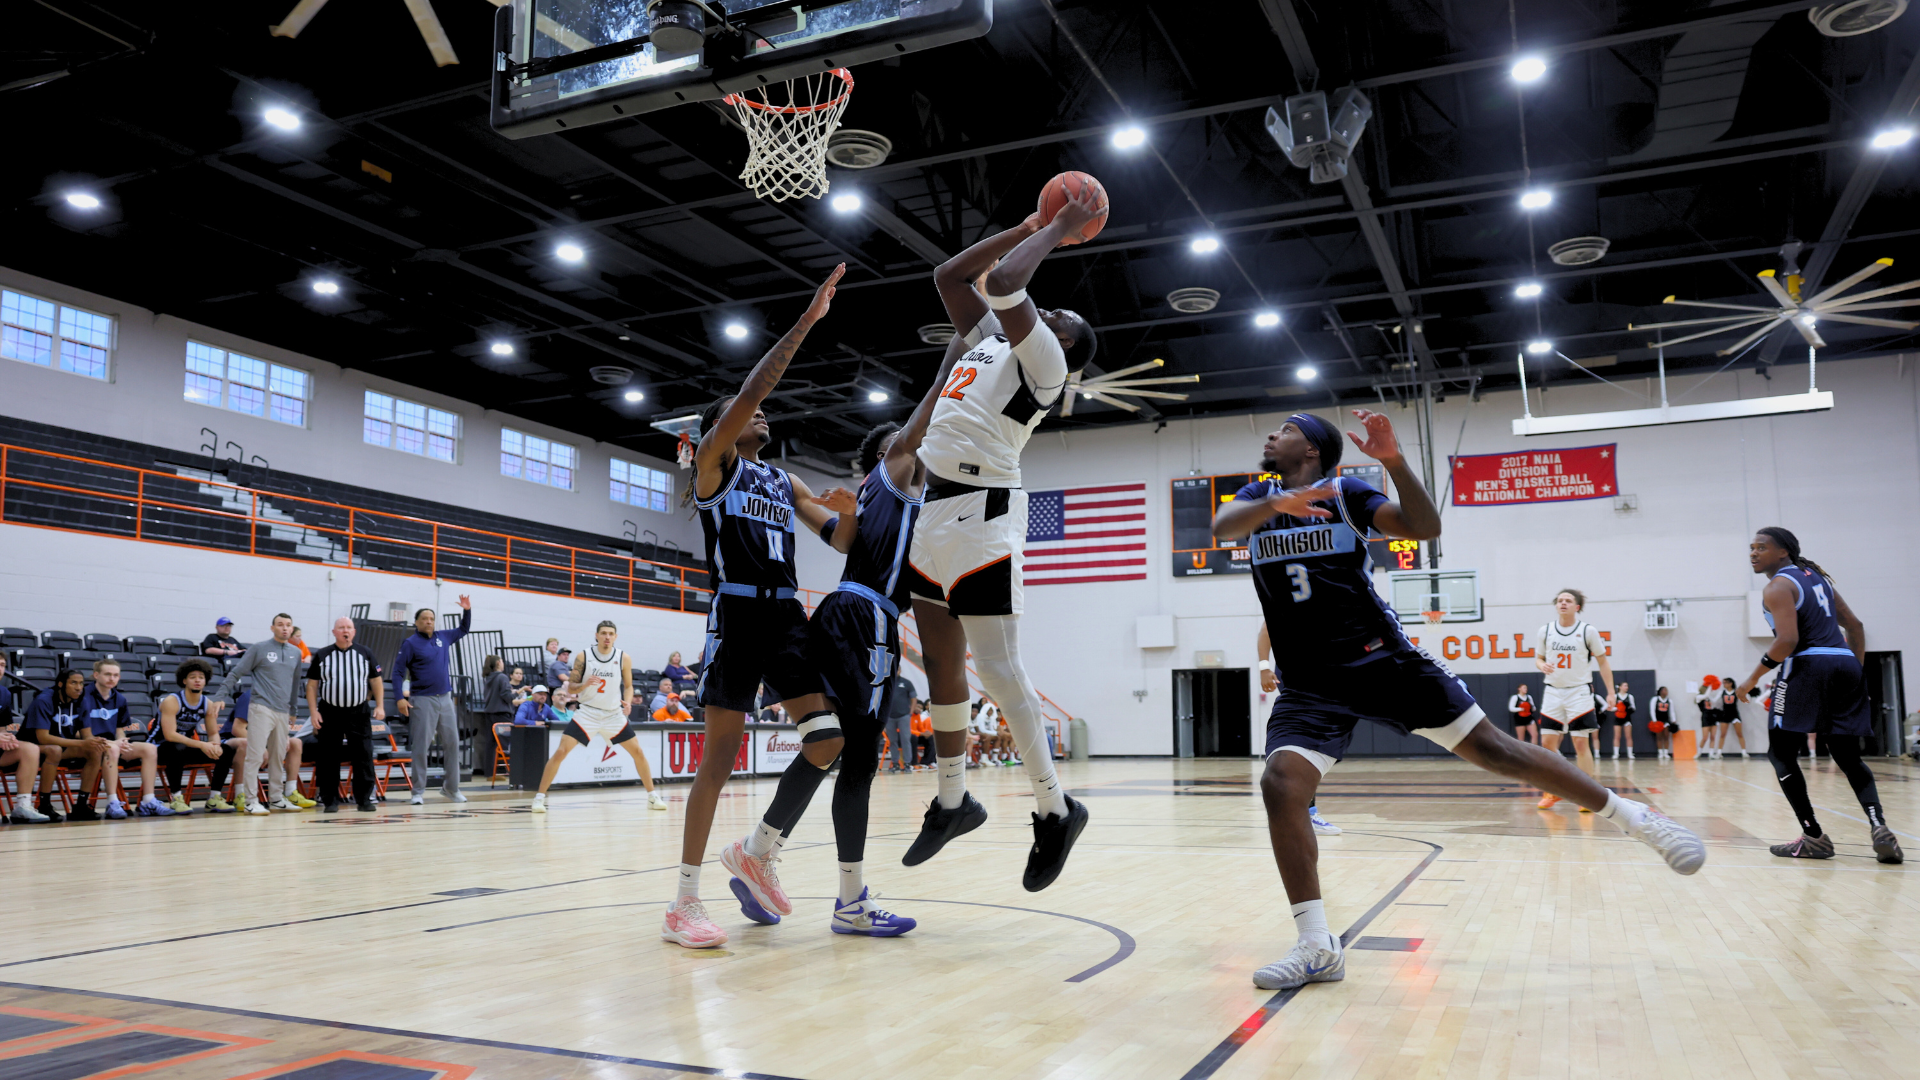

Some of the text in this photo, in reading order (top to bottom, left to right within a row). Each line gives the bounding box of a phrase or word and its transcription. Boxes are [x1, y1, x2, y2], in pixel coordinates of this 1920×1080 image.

[940, 367, 977, 401] 22
[1501, 453, 1561, 468] 2017 NAIA
[1499, 464, 1563, 479] DIVISION II
[1475, 473, 1592, 491] MEN'S BASKETBALL
[1474, 484, 1595, 502] NATIONAL CHAMPION
[766, 527, 786, 563] 11
[1256, 528, 1334, 561] JOHNSON
[1388, 540, 1418, 553] 15:54
[1192, 552, 1207, 569] U
[1231, 549, 1251, 561] BIN
[1398, 551, 1414, 570] 12
[1285, 563, 1312, 603] 3
[1812, 583, 1832, 617] 4
[1442, 631, 1612, 660] COLL
[1552, 641, 1577, 652] Union
[1557, 653, 1572, 669] 21
[592, 667, 614, 678] Union
[597, 679, 606, 694] 2
[668, 732, 750, 774] UNN
